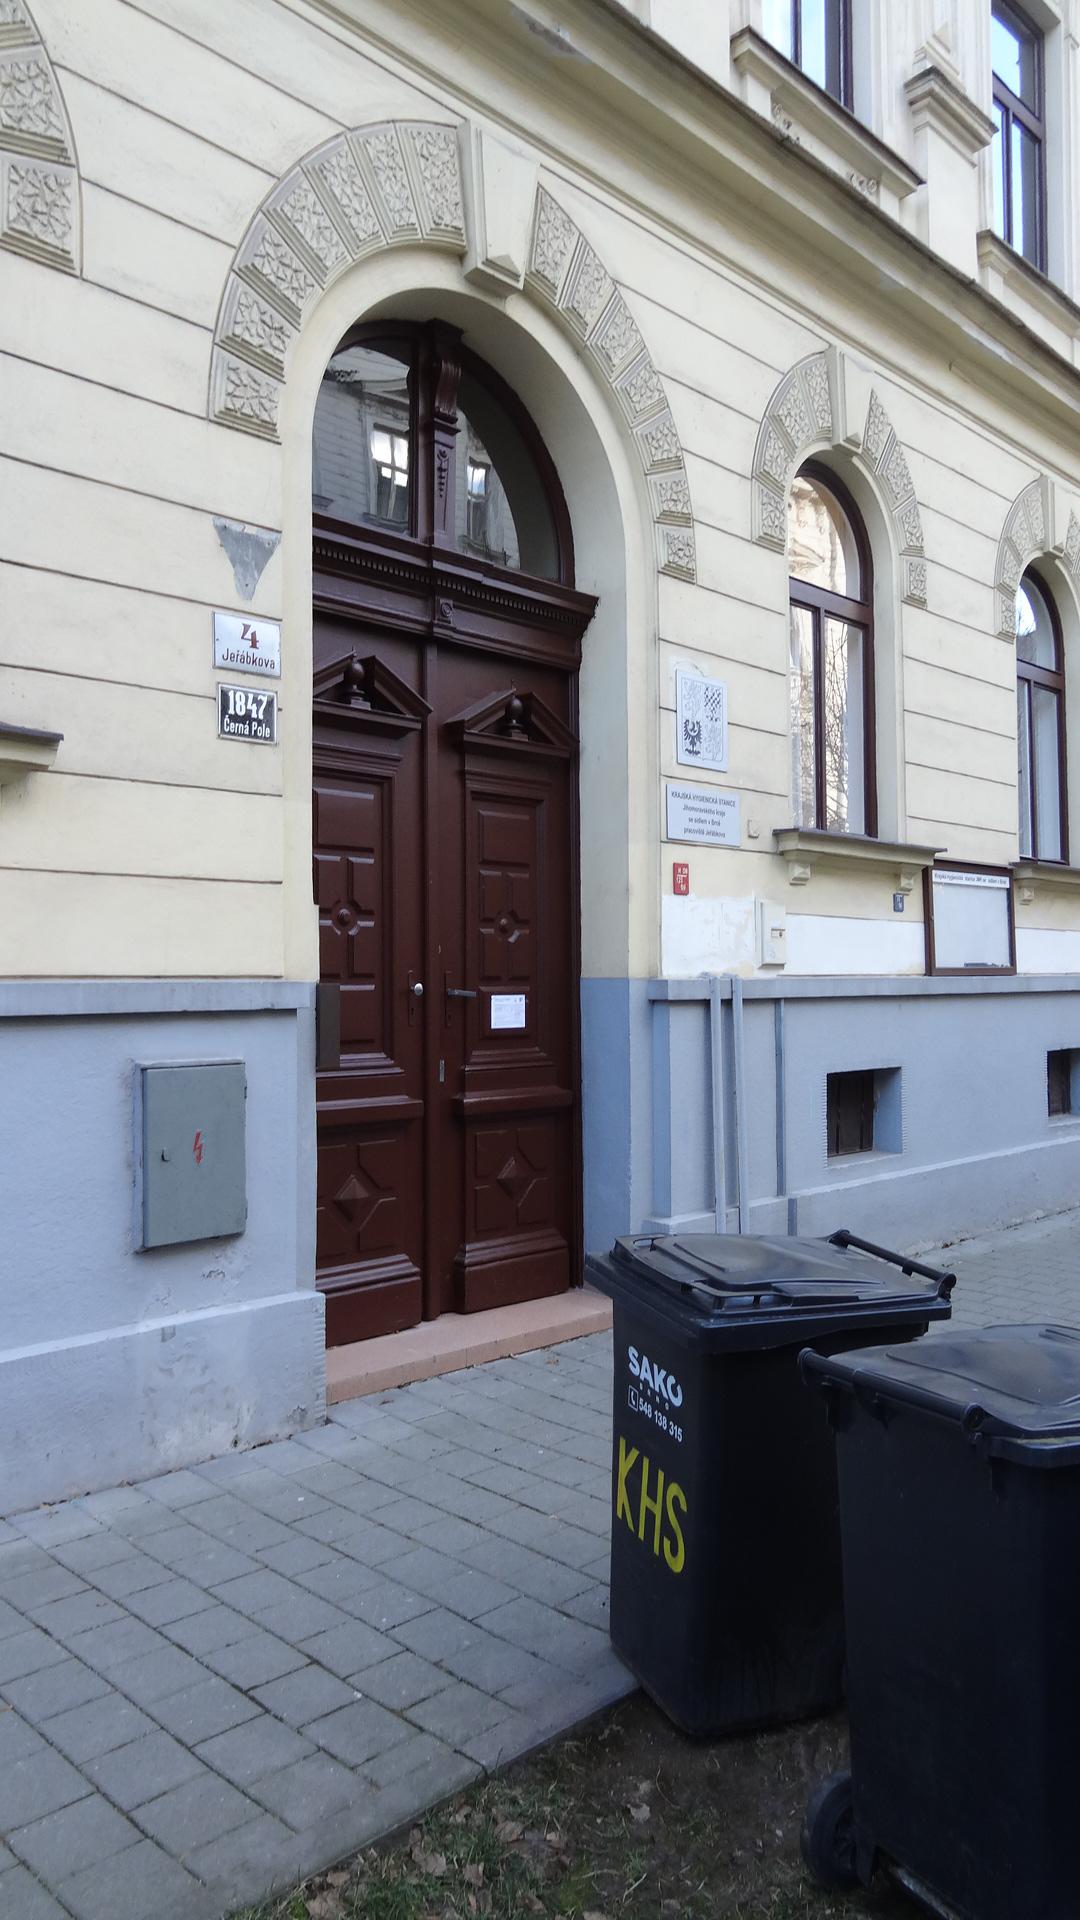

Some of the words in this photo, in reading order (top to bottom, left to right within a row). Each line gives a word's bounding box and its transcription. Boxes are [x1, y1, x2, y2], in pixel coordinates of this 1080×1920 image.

[240, 623, 259, 649] 4
[222, 648, 275, 669] Jeřábkova
[228, 689, 268, 720] 1847
[223, 714, 249, 735] Černá
[251, 721, 271, 738] Pole
[628, 1346, 683, 1407] SAKO
[639, 1397, 653, 1418] 548
[654, 1410, 668, 1431] 138
[669, 1421, 683, 1442] 315
[617, 1435, 688, 1573] KHS
